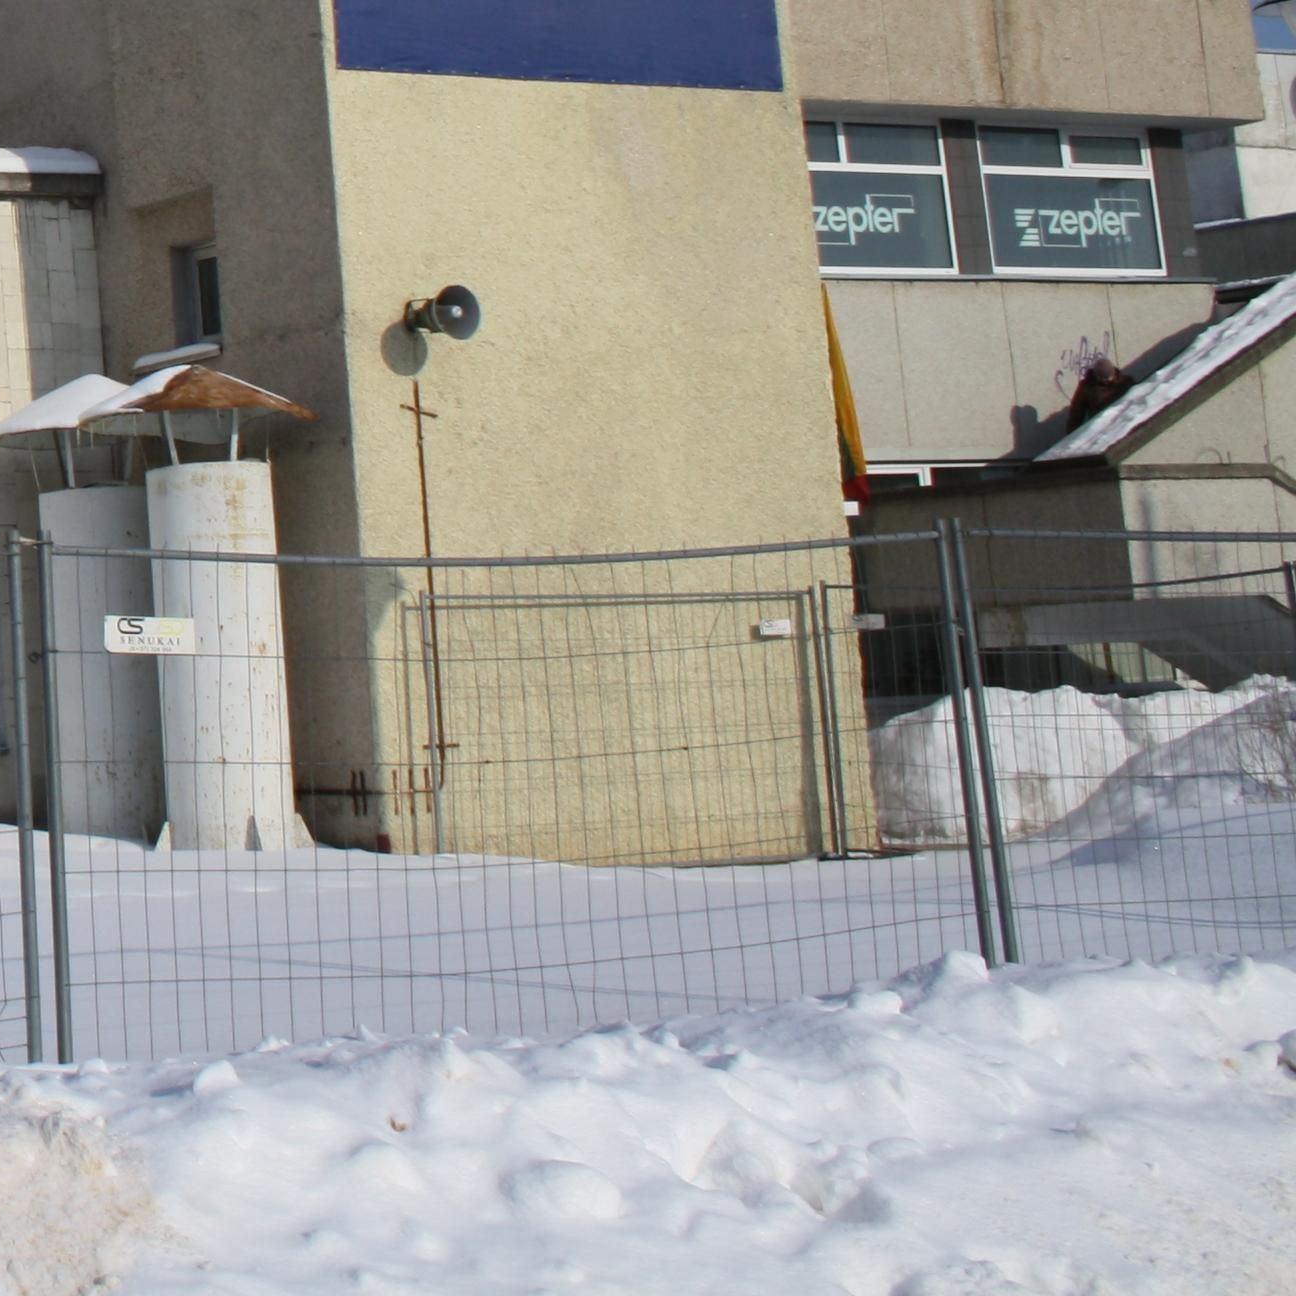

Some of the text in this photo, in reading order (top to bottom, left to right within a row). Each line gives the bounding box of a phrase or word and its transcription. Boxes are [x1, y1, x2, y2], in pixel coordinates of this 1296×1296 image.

[812, 194, 915, 245] zepter
[1038, 198, 1141, 247] zepter
[120, 635, 181, 646] SENUKAI
